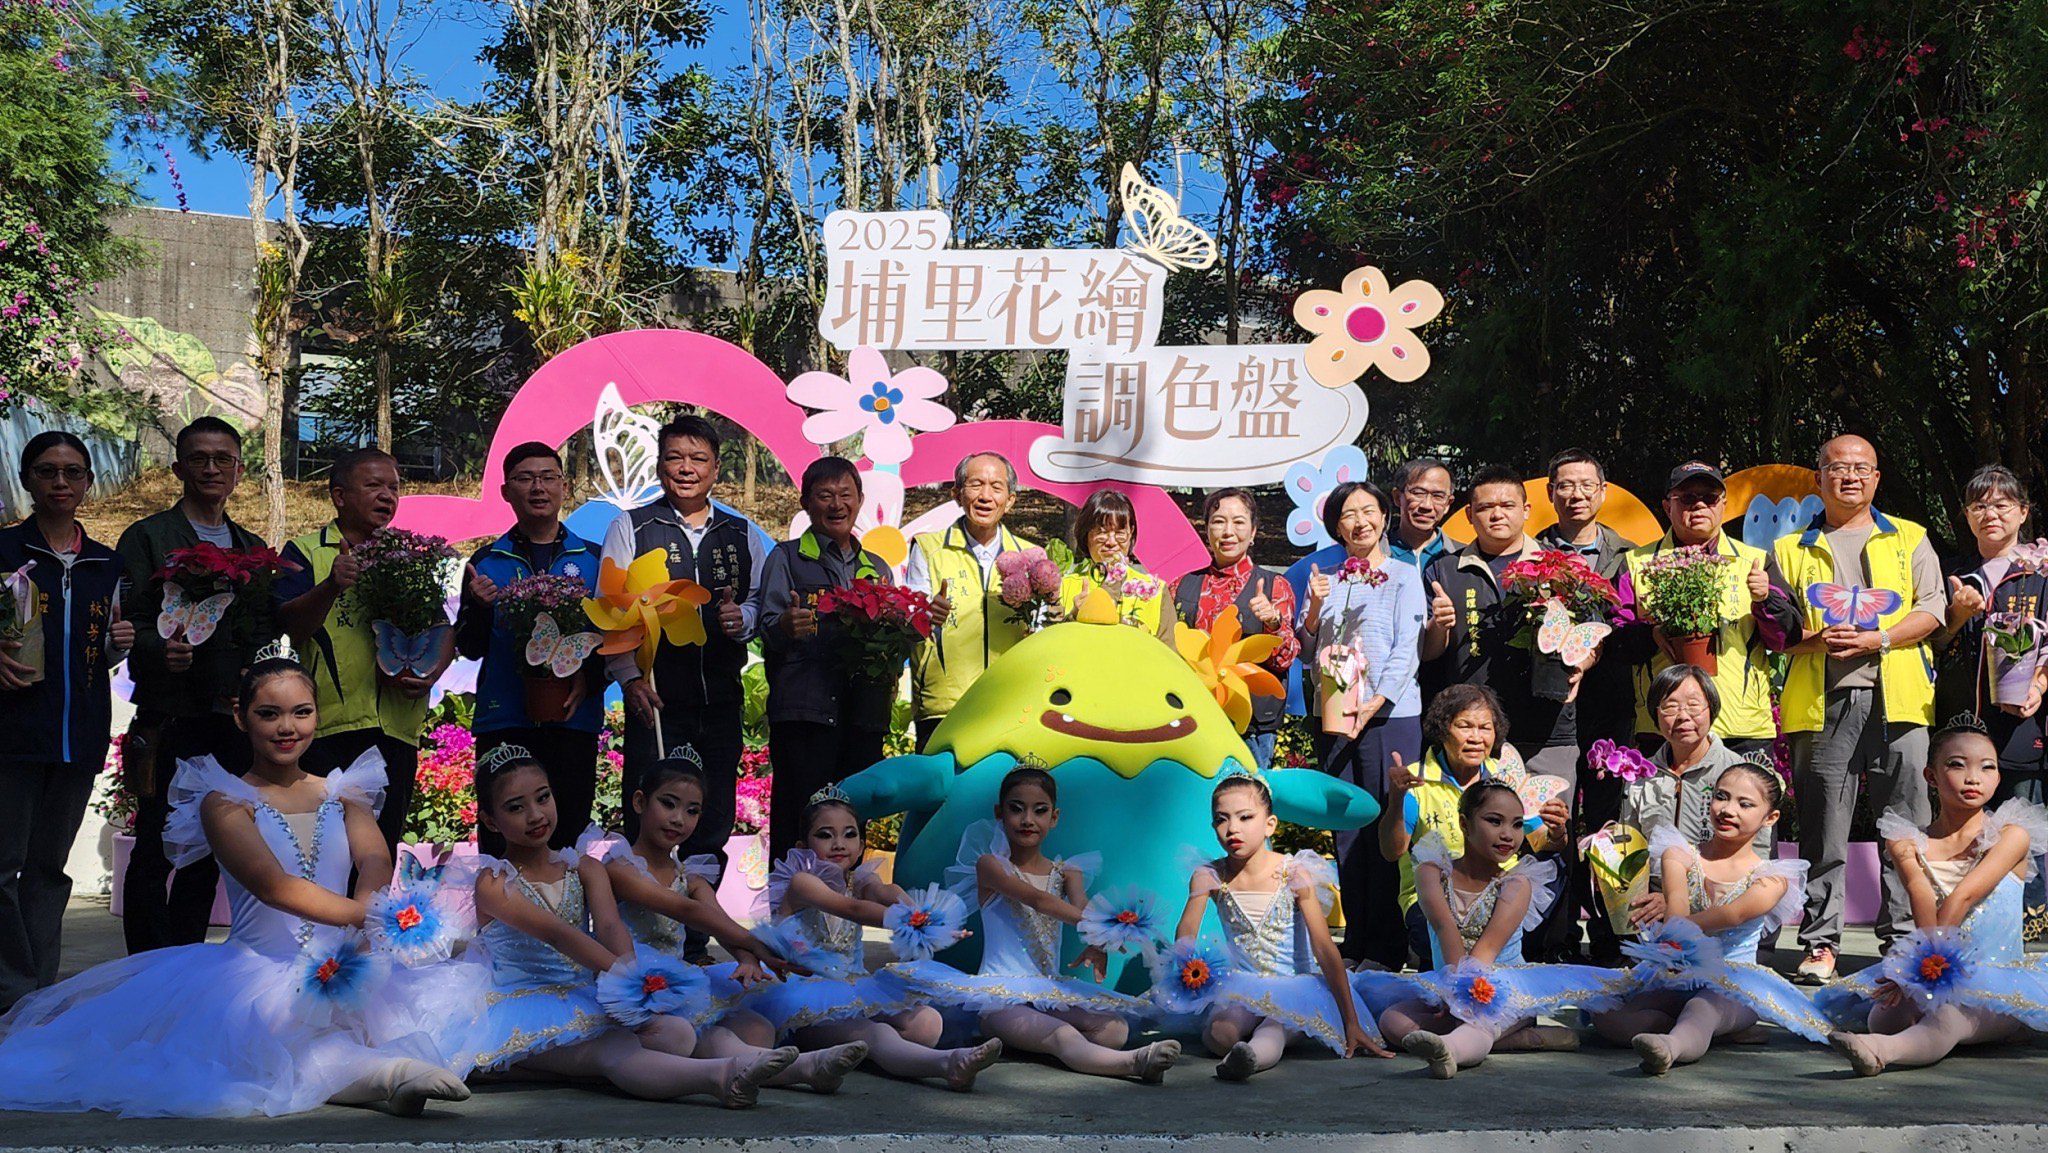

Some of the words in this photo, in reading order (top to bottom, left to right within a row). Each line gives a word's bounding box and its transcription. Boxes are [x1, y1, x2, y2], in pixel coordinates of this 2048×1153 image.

[838, 217, 938, 251] 2025
[830, 255, 1154, 354] 埔里花繪
[1072, 353, 1301, 444] 調色盤
[669, 542, 682, 564] 主任
